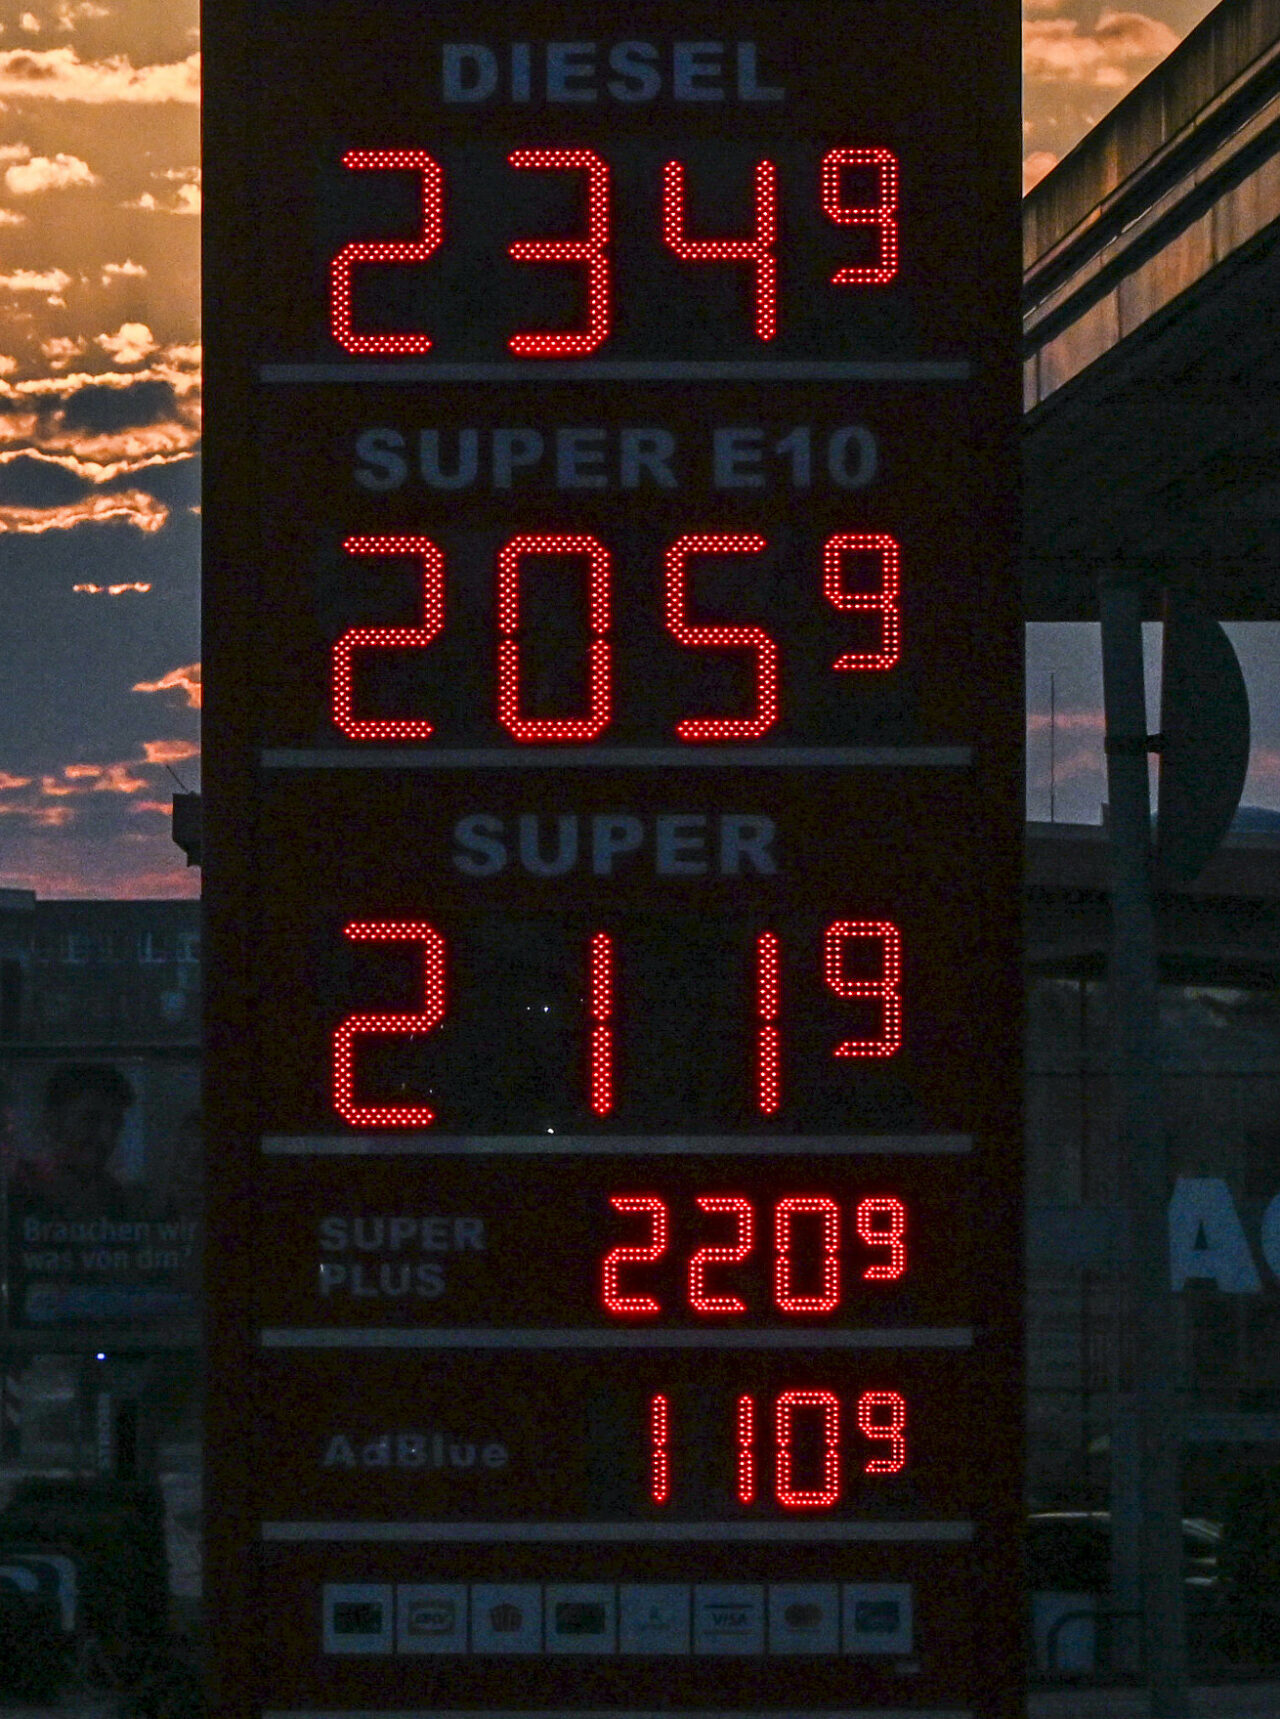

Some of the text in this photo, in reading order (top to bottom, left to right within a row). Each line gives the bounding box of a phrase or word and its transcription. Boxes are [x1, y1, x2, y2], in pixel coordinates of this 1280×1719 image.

[442, 40, 784, 103] DIESEL
[354, 425, 878, 490] SUPER E10
[453, 813, 777, 877] SUPER
[23, 1214, 199, 1243] Brauchen wir
[320, 1216, 487, 1251] SUPER
[22, 1249, 74, 1270] was
[81, 1248, 129, 1270] von
[319, 1262, 447, 1299] PLUS
[323, 1433, 510, 1468] AdBlue
[711, 1612, 748, 1627] VISA
